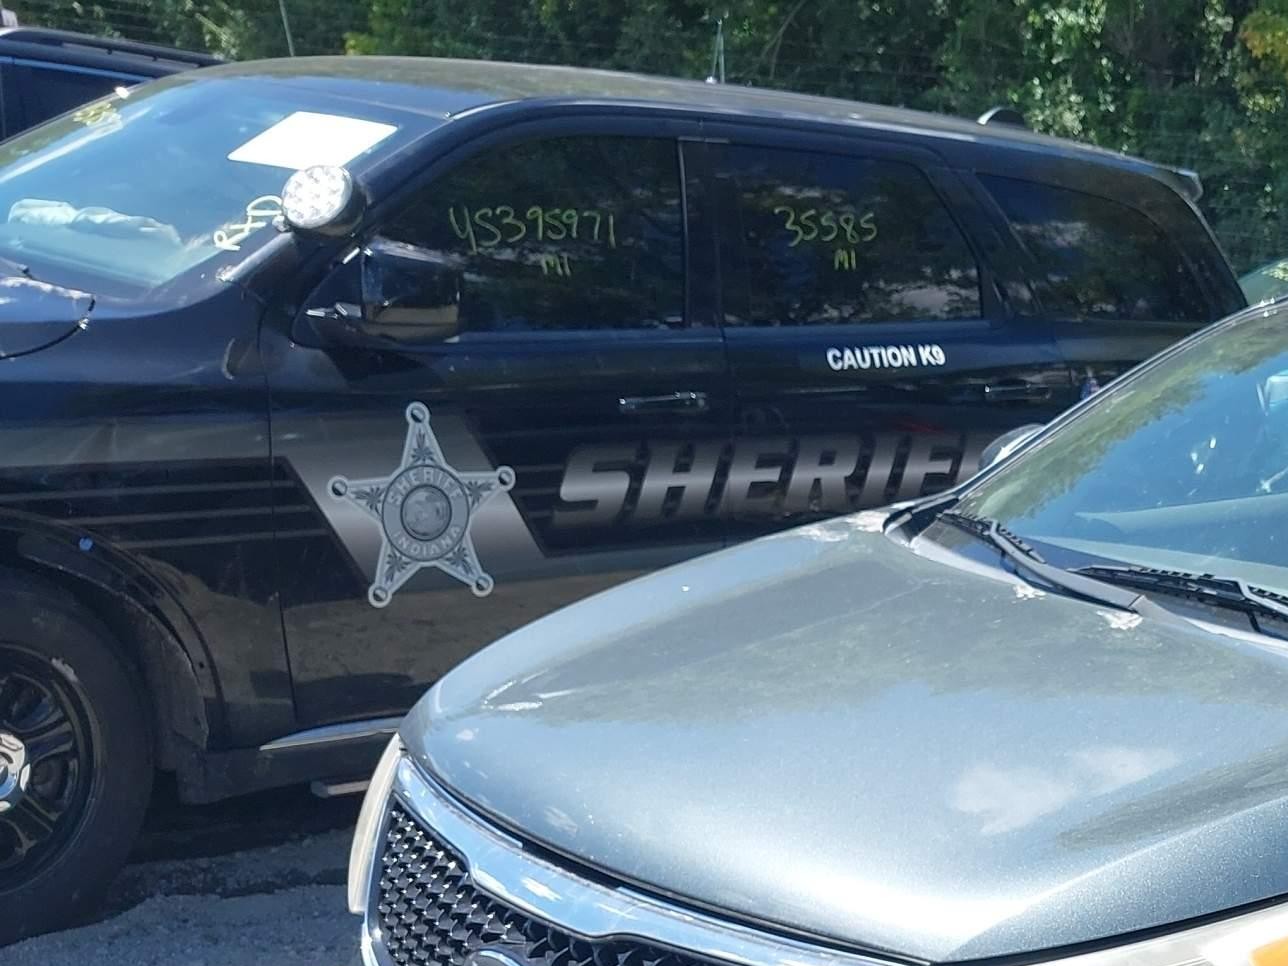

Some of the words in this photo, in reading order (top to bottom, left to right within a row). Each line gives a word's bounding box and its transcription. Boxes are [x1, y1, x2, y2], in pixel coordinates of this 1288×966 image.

[449, 205, 616, 256] 45395971
[774, 206, 877, 247] 35585
[833, 248, 857, 271] MI
[826, 345, 917, 371] CAUTION
[918, 344, 946, 366] K9
[386, 467, 465, 506] SHERIFF
